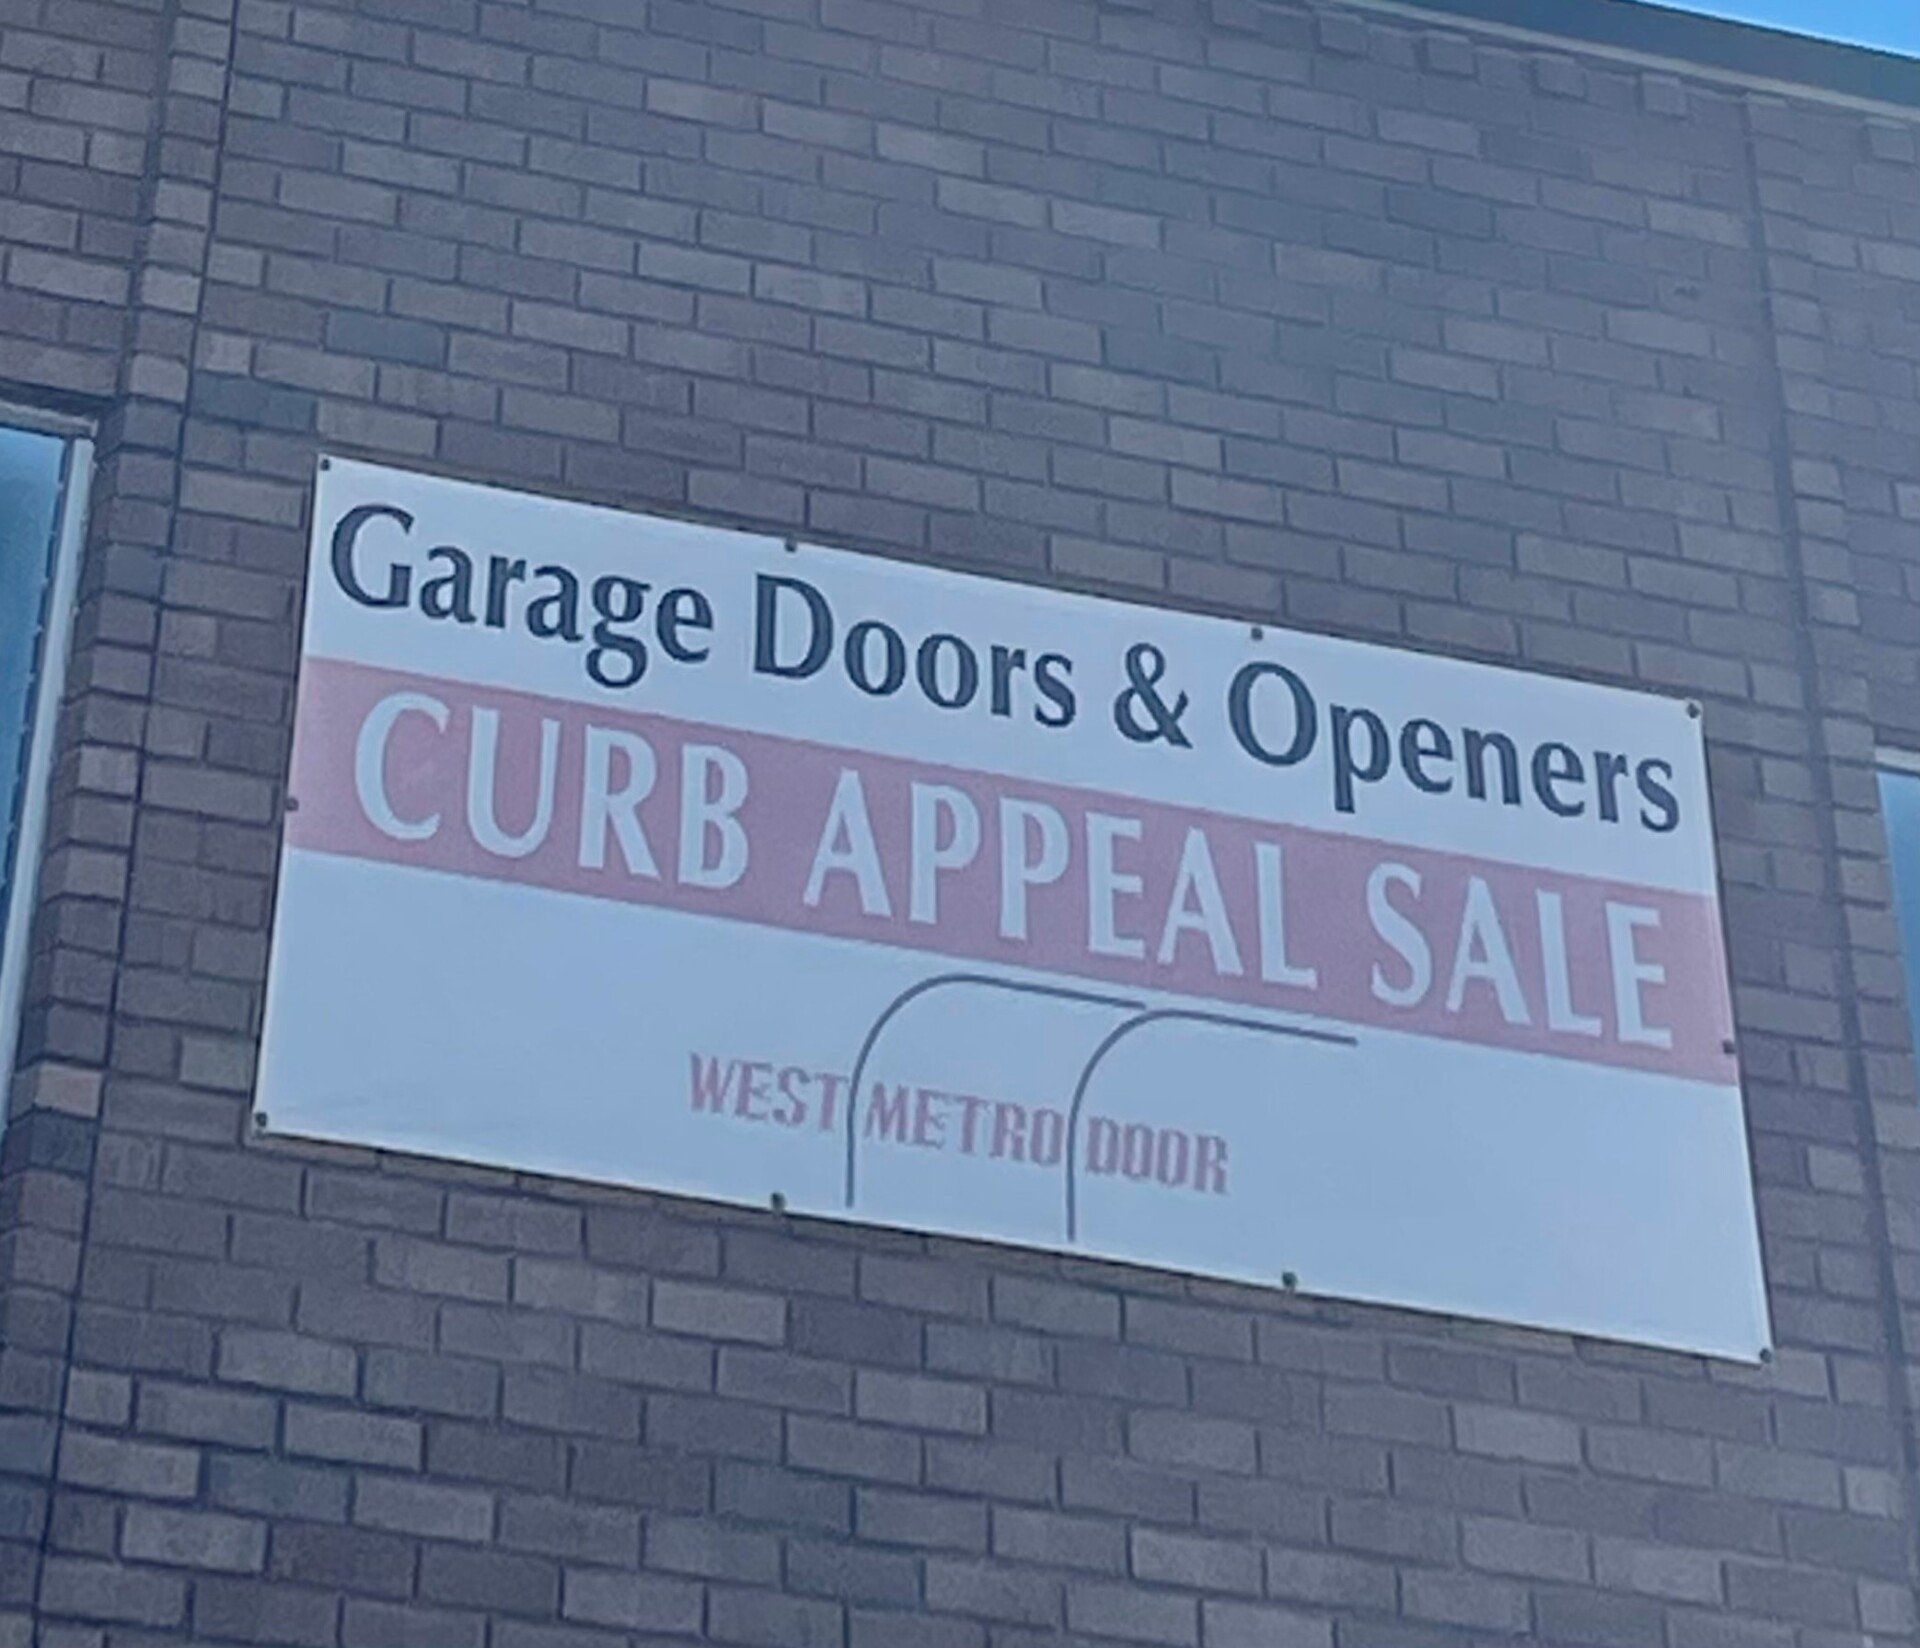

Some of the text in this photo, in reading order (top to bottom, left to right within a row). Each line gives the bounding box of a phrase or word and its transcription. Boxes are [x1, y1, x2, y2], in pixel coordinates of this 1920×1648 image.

[330, 503, 1680, 834] Garage Doors & Openers
[354, 692, 1674, 1049] CURB APPEAL SALE
[690, 1052, 1228, 1194] WEST METRO DOOR
